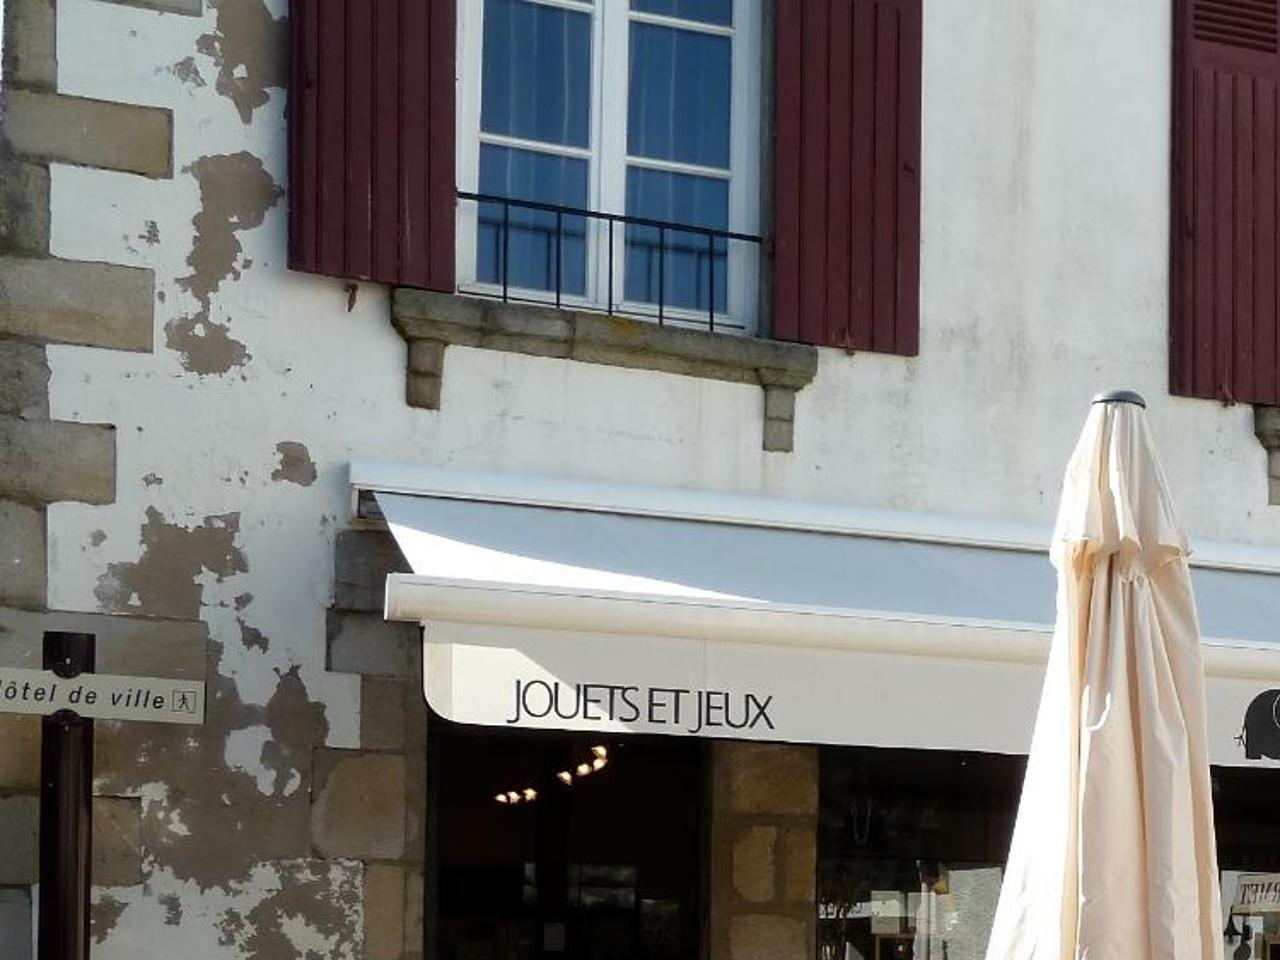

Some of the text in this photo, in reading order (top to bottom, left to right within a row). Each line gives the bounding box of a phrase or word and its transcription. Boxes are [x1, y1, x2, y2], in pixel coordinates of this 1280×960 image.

[0, 680, 165, 709] ôtel de ville
[506, 680, 775, 733] JOUETS ET JEUX
